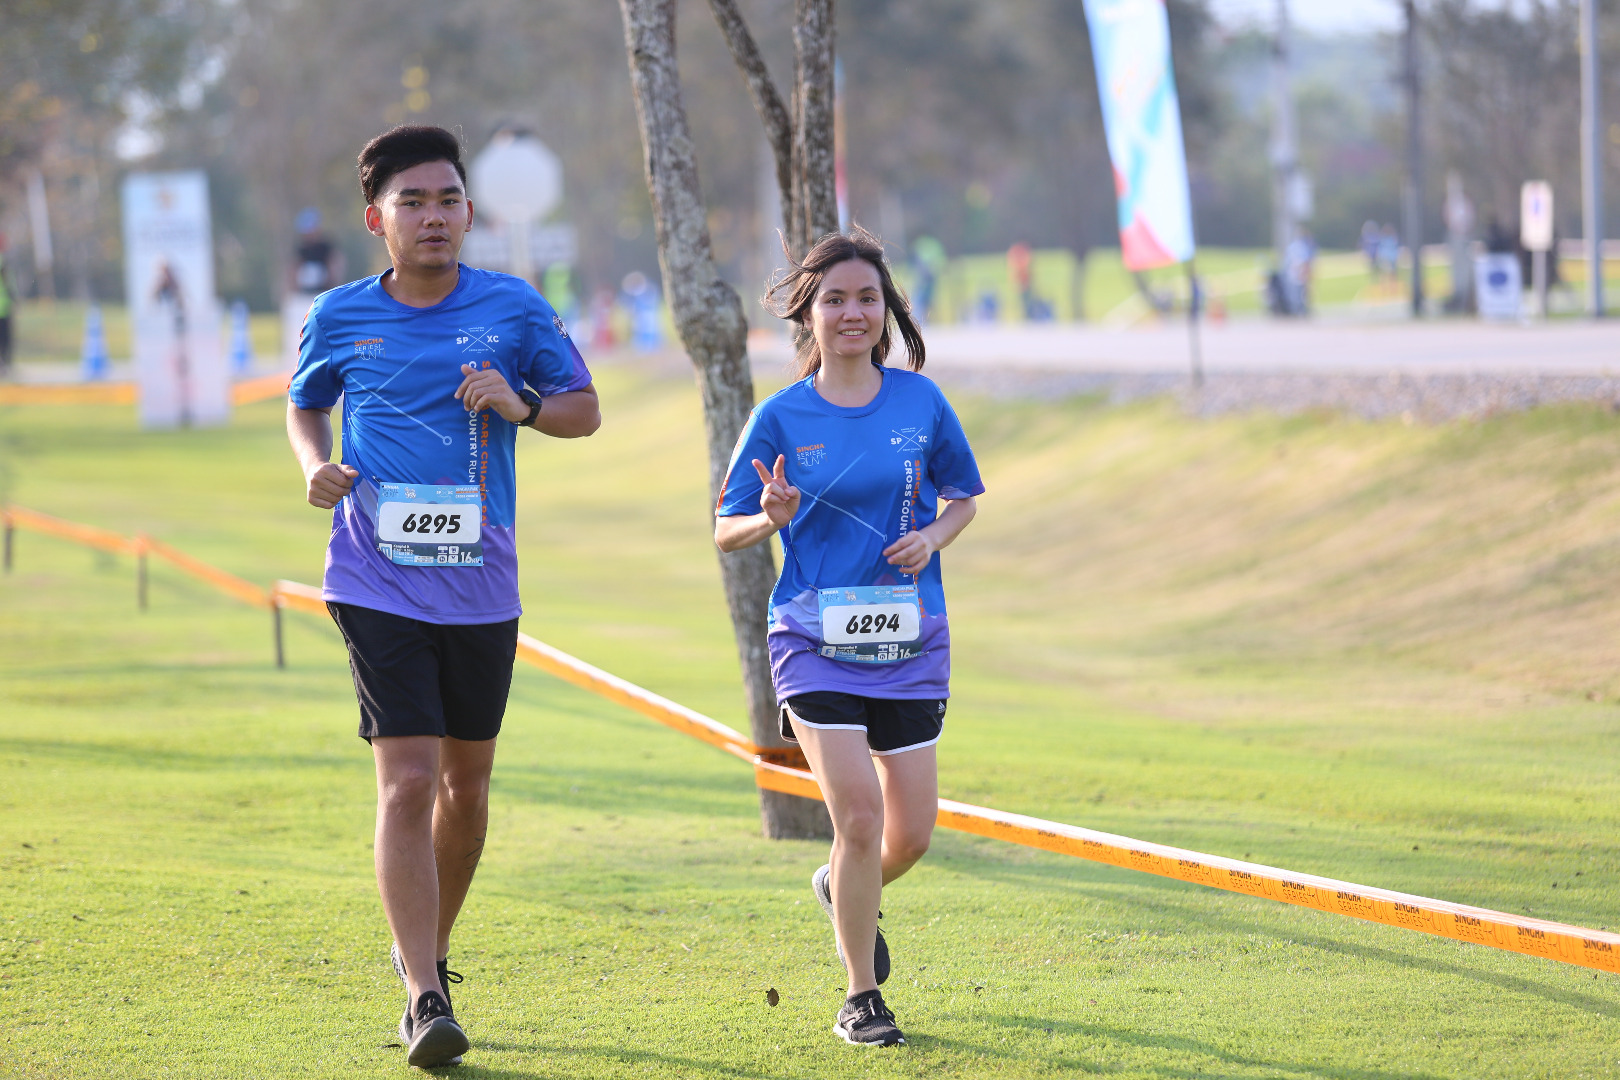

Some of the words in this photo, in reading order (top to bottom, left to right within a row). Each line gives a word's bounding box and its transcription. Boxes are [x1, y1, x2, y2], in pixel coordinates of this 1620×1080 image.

[354, 338, 384, 347] SINGHA
[456, 336, 469, 345] SP
[486, 335, 500, 343] XC
[468, 409, 477, 457] OUNTRY
[481, 414, 489, 448] PARK
[796, 443, 825, 453] SINGHA
[890, 437, 902, 445] SP
[918, 435, 928, 443] XC
[468, 460, 477, 483] RUN
[904, 460, 912, 496] CROSS
[402, 513, 461, 533] 6295
[900, 499, 910, 536] COUNT
[845, 613, 899, 634] 6294
[1454, 913, 1481, 927] SINGHA
[1517, 925, 1545, 940] SINGHA
[1518, 937, 1548, 954] SERIES
[1583, 939, 1613, 953] SINGHA
